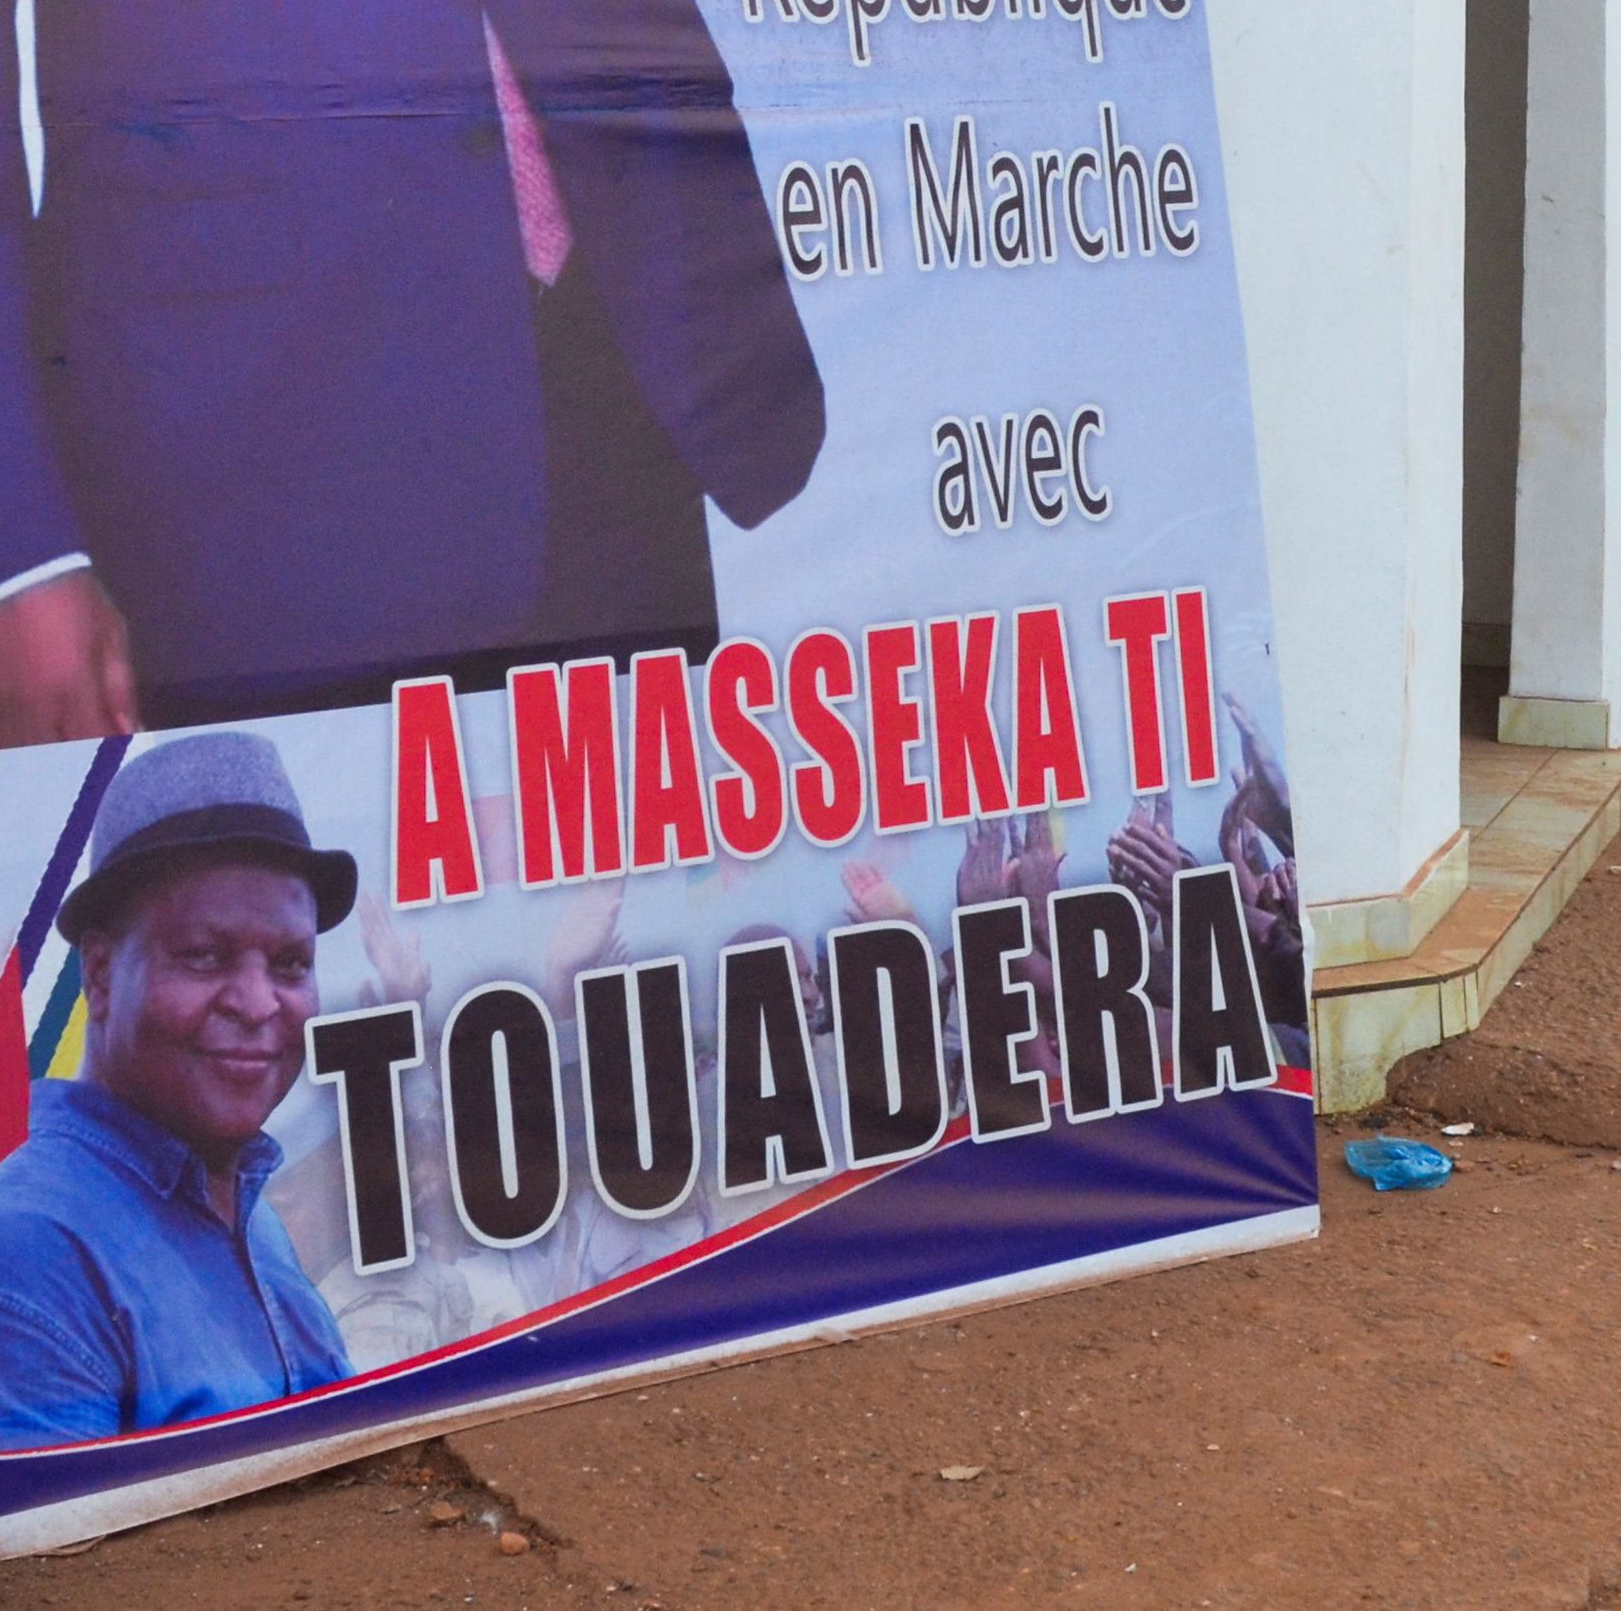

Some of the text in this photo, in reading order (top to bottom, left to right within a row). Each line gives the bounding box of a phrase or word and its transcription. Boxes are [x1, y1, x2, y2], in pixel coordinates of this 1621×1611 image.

[781, 104, 1198, 280] en Marche
[934, 403, 1111, 535] avec
[392, 586, 1220, 908] A MASSEKA TI
[305, 862, 1278, 1274] TOUADERA
